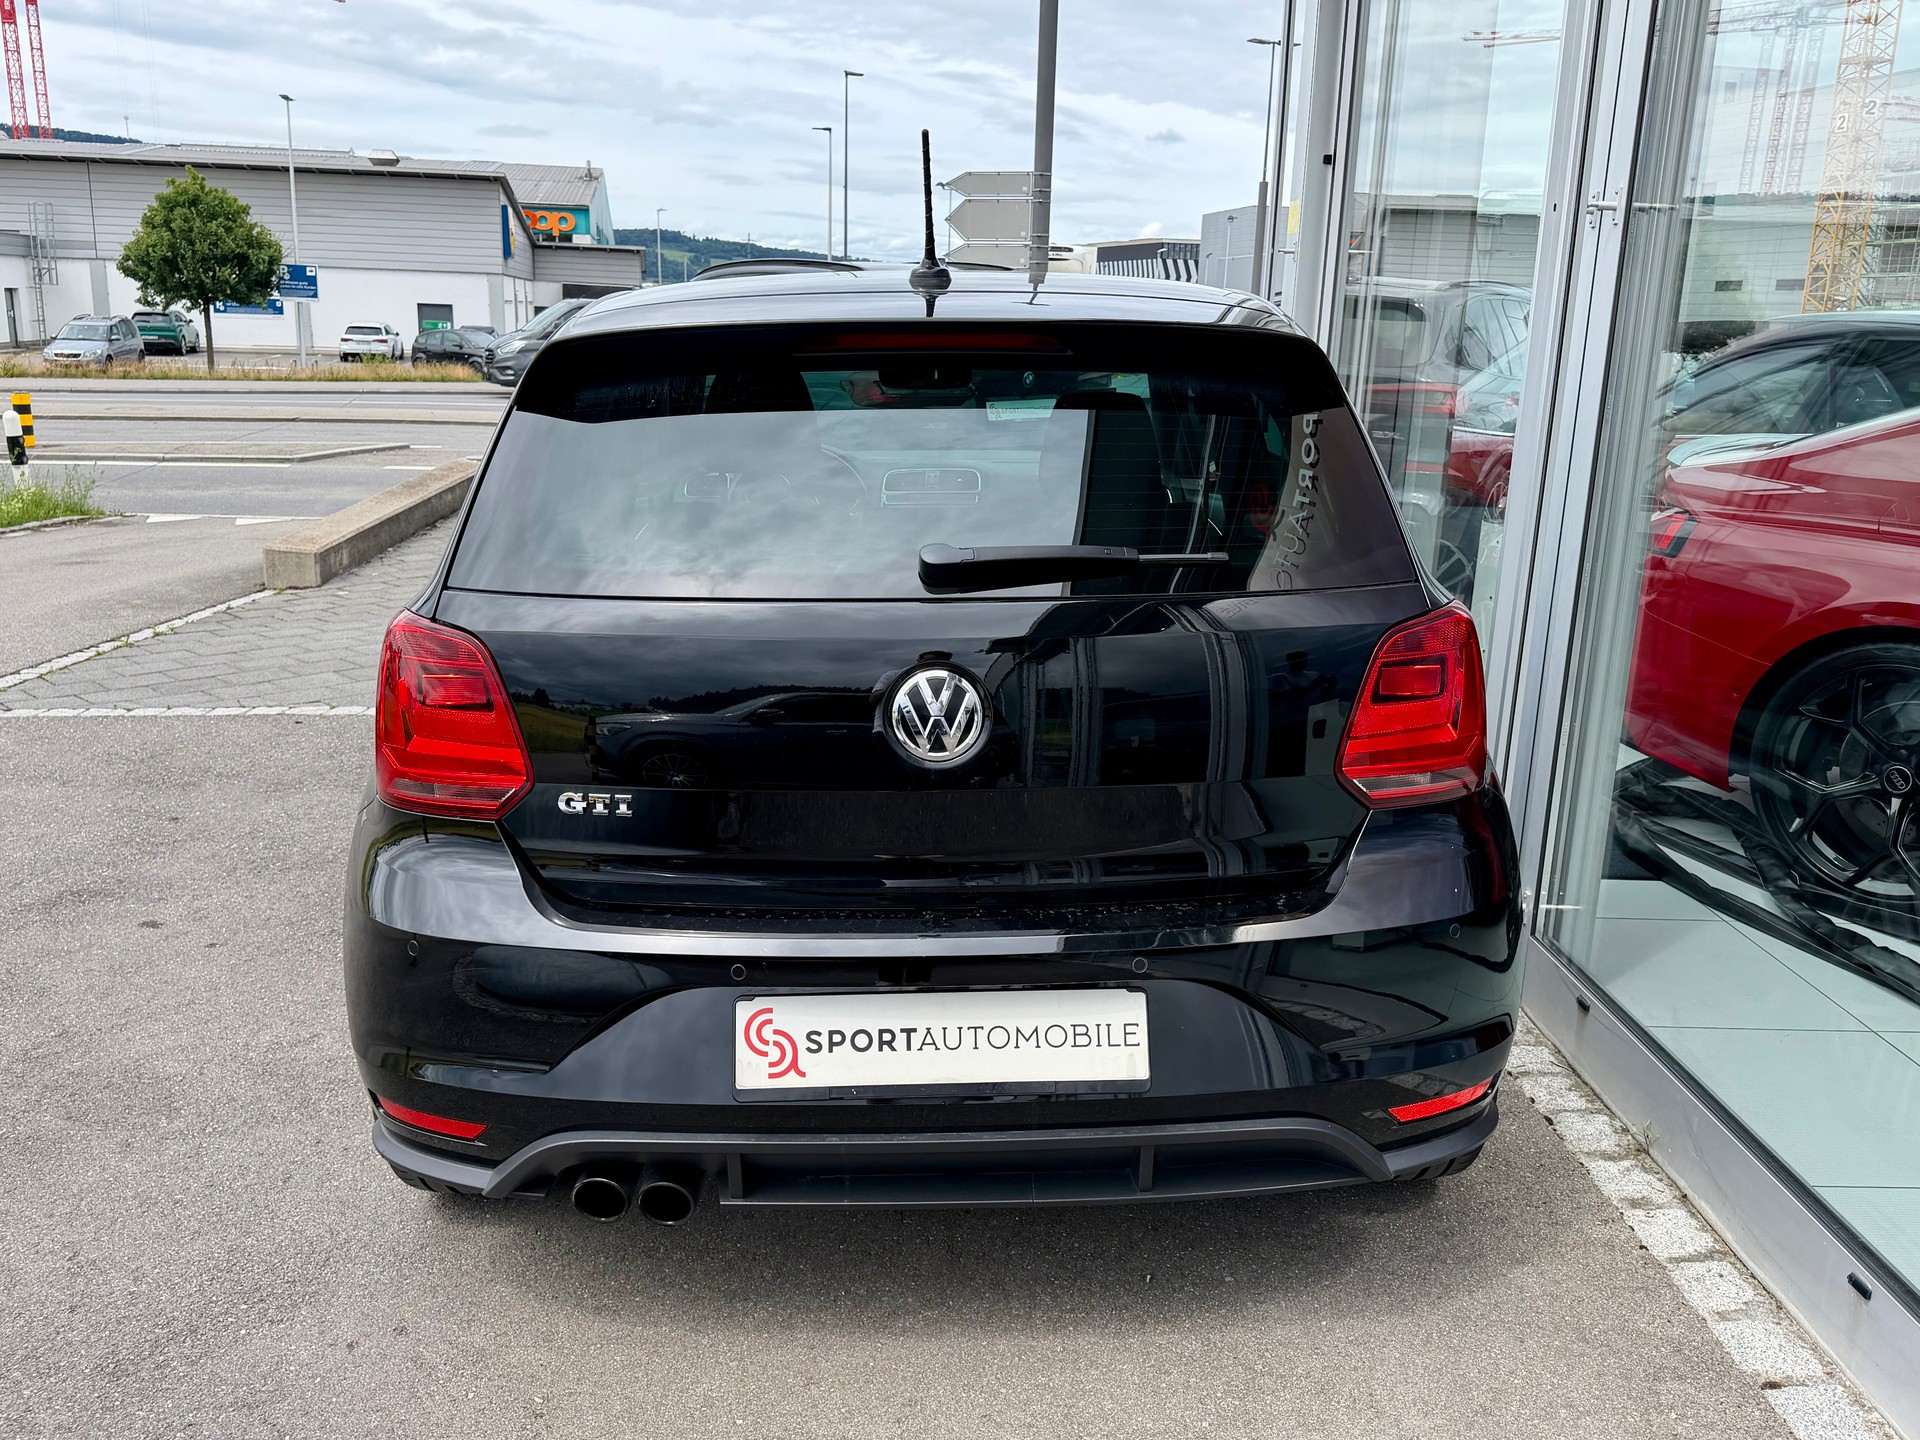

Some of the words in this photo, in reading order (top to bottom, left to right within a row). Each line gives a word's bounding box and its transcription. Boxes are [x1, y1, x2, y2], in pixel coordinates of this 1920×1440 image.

[521, 209, 576, 237] oop
[557, 791, 633, 817] GTI
[805, 1022, 1141, 1054] SPORTAUTOMOBILE
